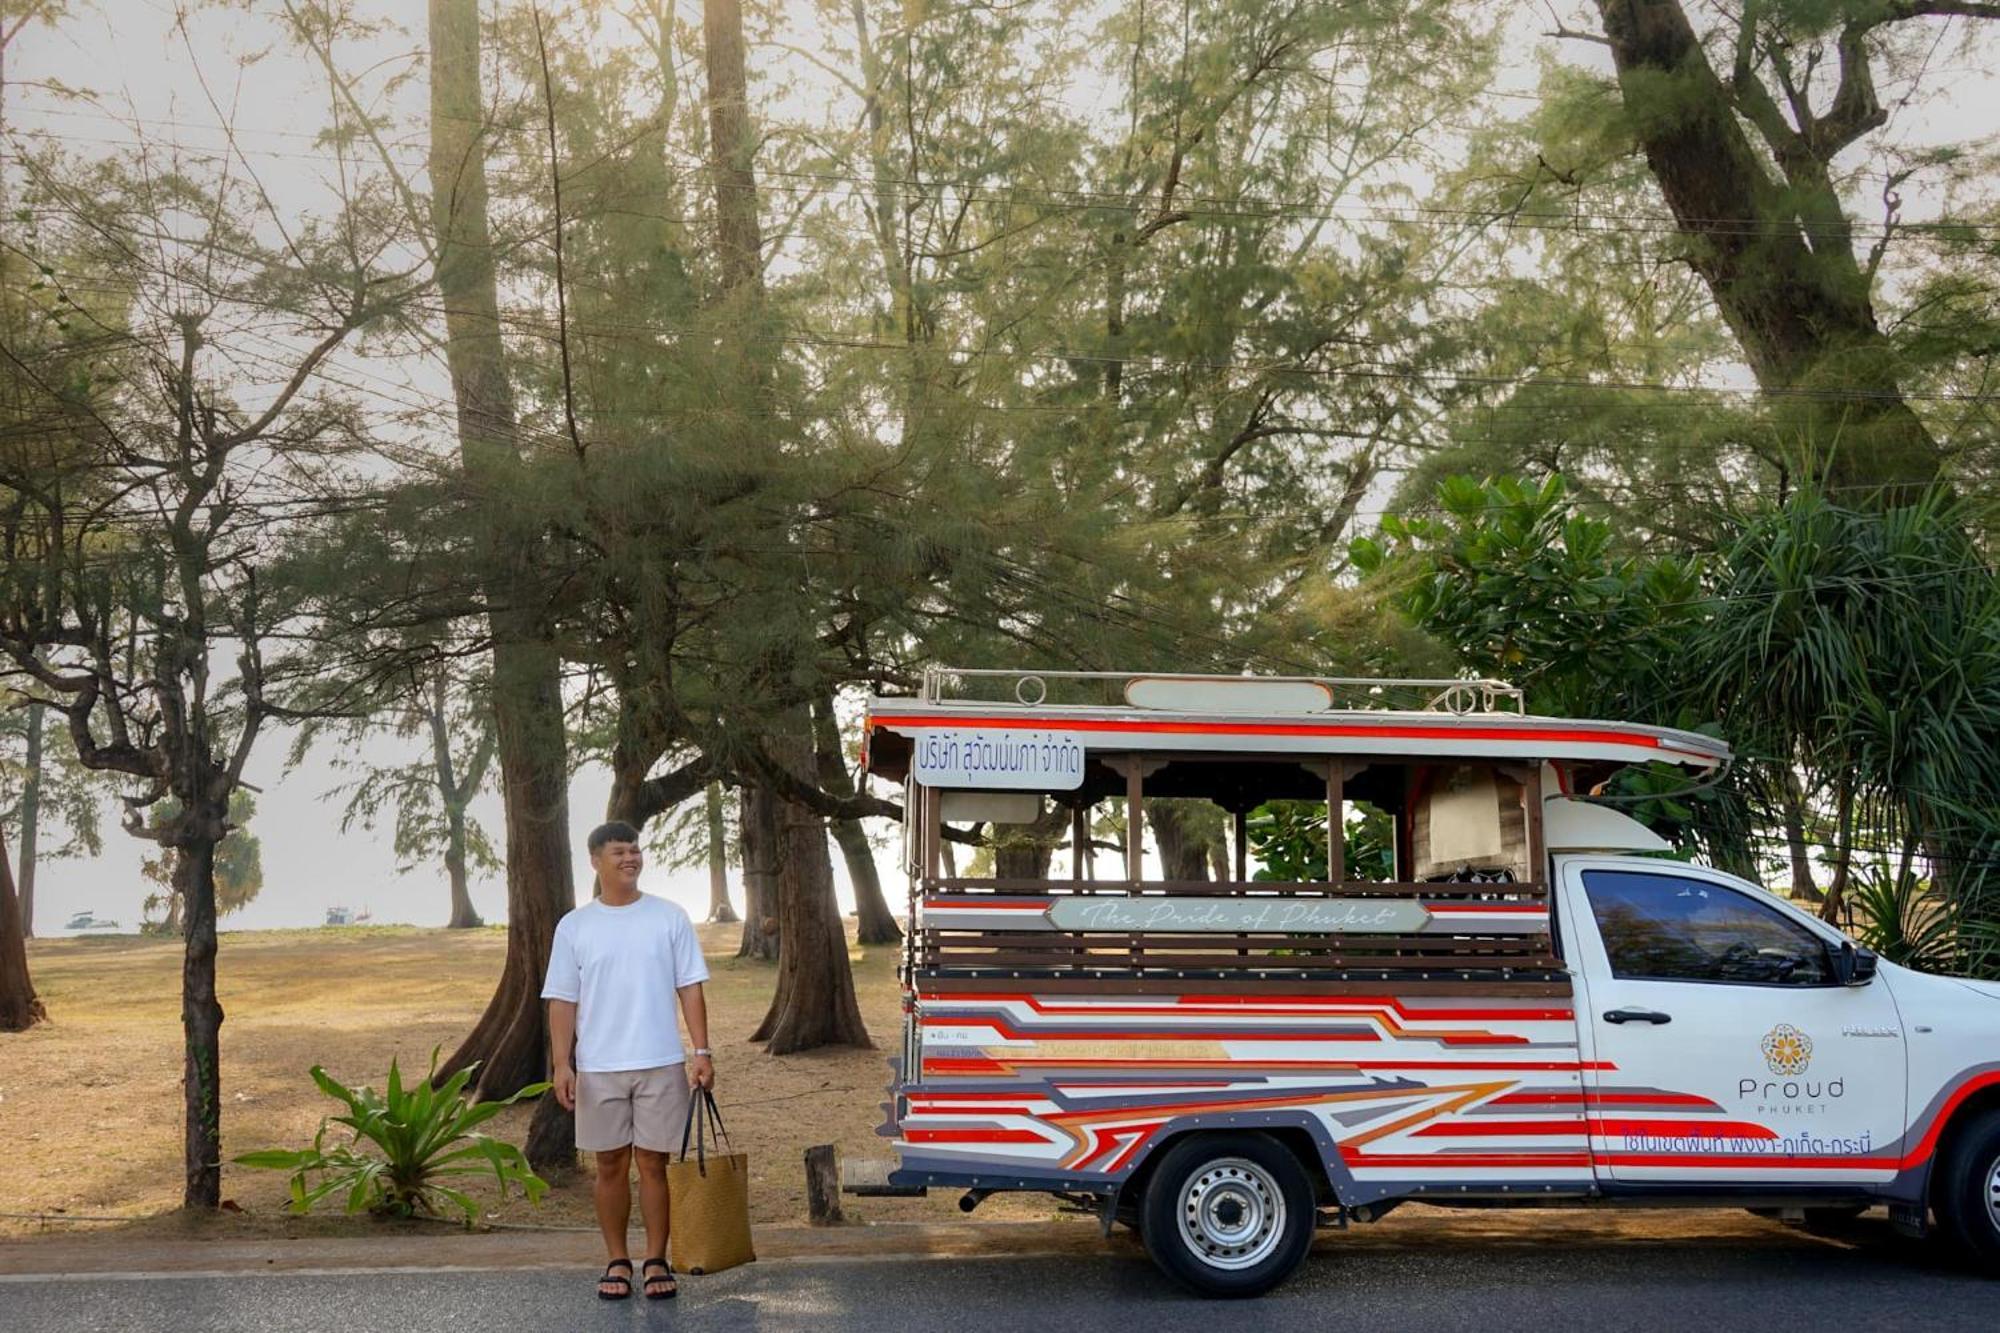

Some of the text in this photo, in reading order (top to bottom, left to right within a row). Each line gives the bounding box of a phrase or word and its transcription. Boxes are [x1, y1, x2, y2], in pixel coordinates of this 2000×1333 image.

[1042, 734, 1080, 773] จำกัด
[1080, 900, 1396, 930] The Pride of Phuket
[1739, 1077, 1844, 1099] Proud
[1758, 1104, 1826, 1114] PHUKET
